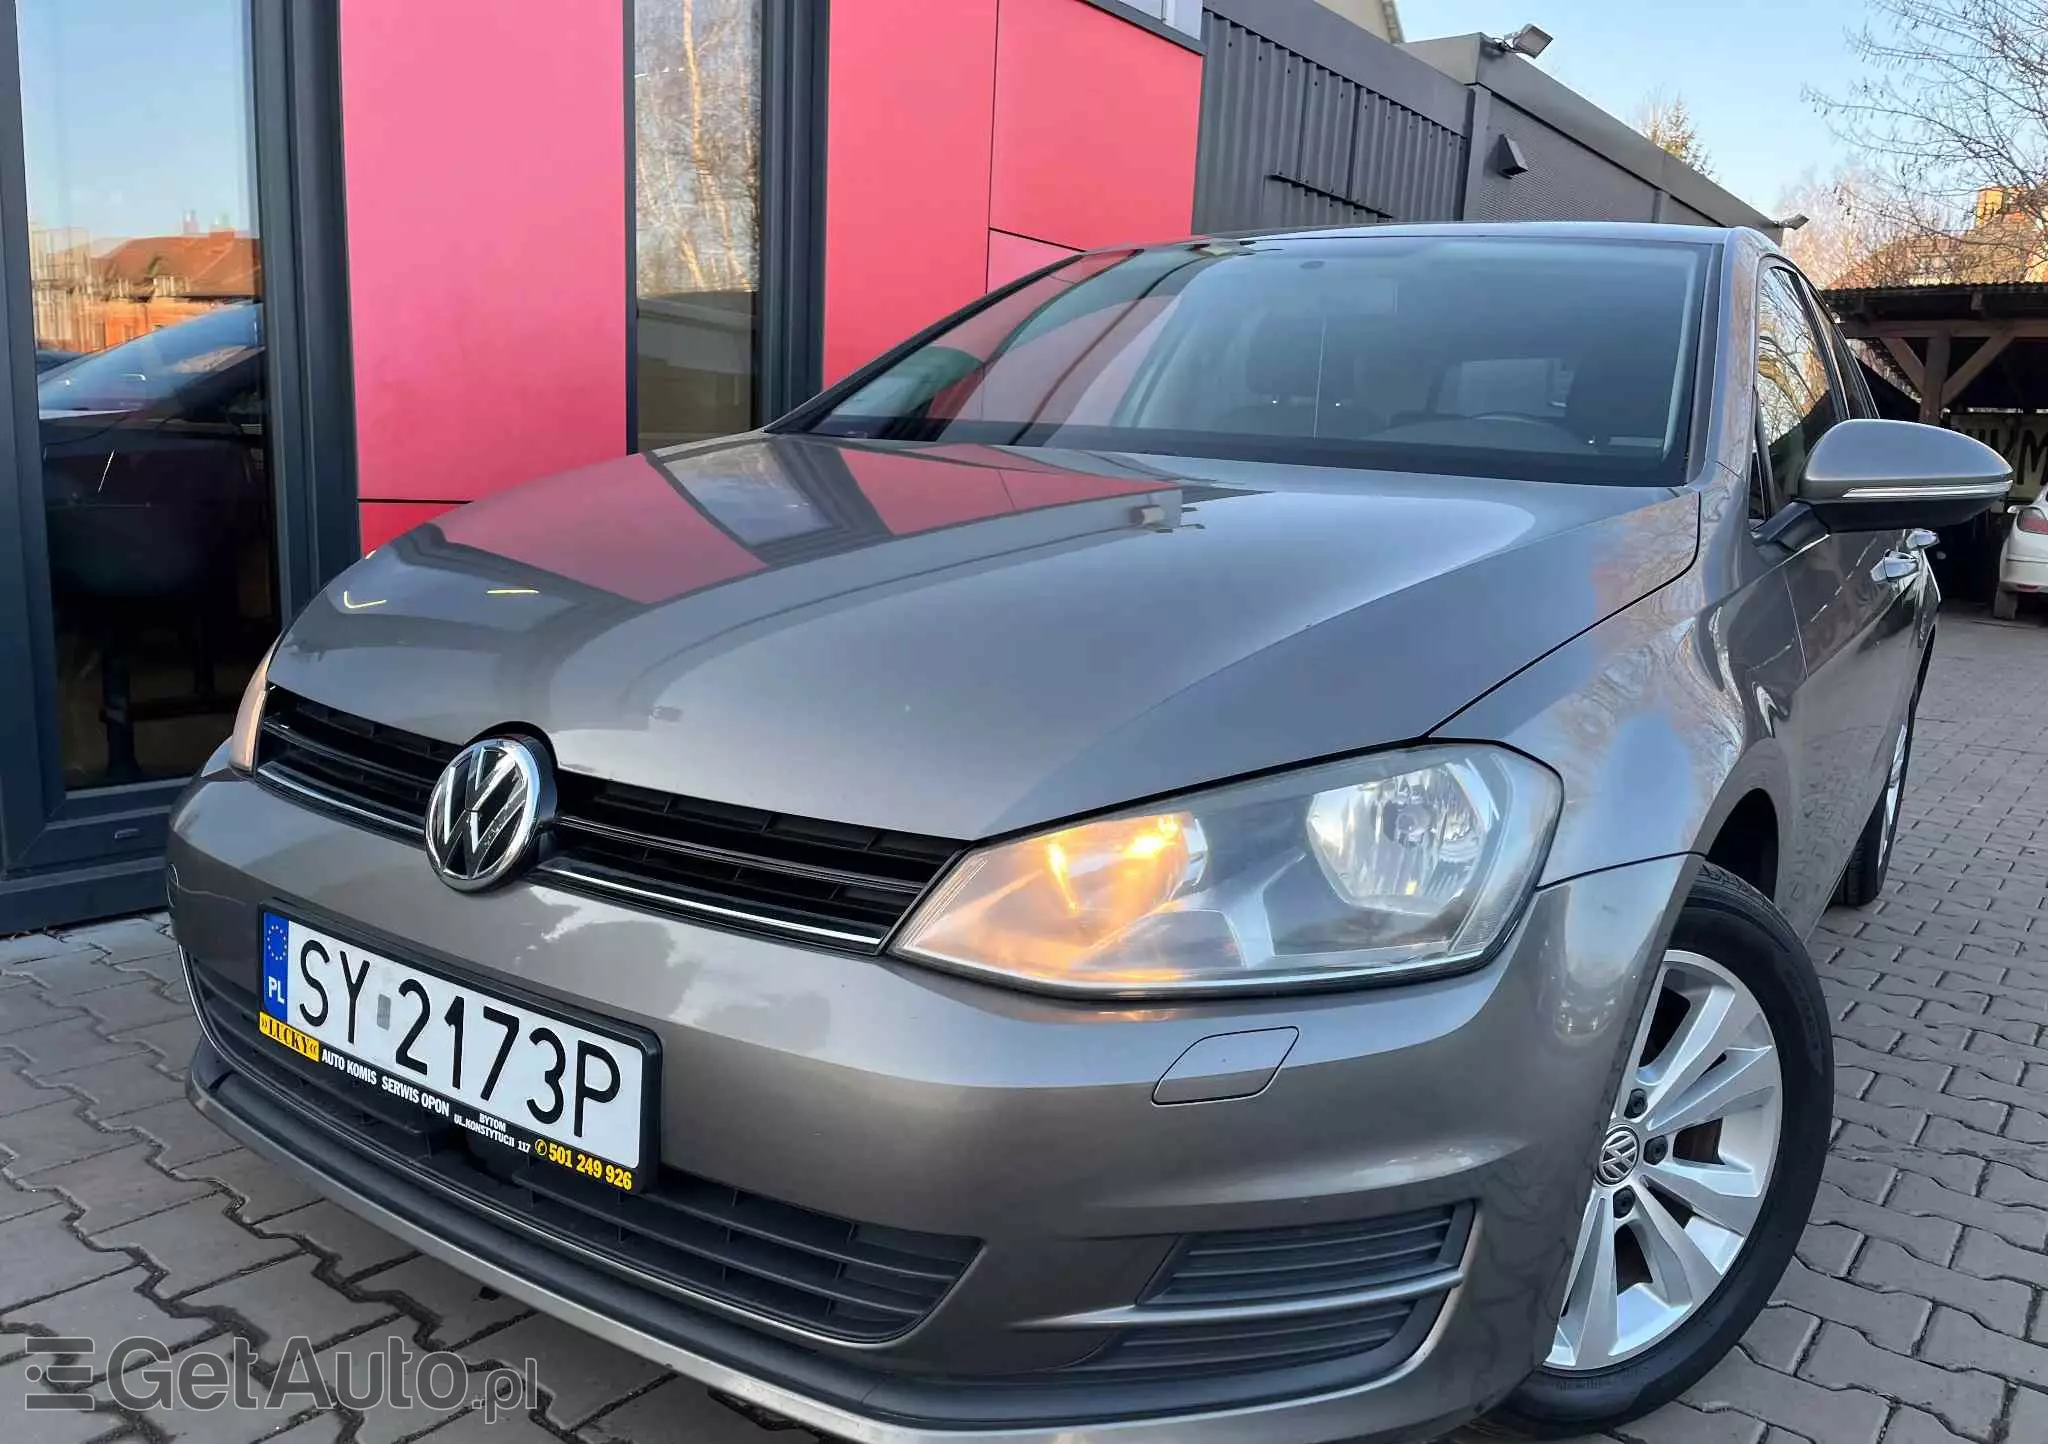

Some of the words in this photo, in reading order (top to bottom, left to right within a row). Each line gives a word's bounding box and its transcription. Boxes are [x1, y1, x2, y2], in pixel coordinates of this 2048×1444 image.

[268, 976, 285, 1004] PL
[299, 939, 371, 1044] SY
[395, 978, 622, 1138] 2173P
[322, 1048, 345, 1071] AUTO
[346, 1059, 377, 1085] KOMIS
[381, 1075, 420, 1104] SERWIS
[420, 1092, 450, 1117] OPON
[479, 1112, 506, 1133] BYTOM
[518, 1140, 531, 1153] 117
[548, 1142, 573, 1168] 501
[576, 1153, 602, 1179] 249
[605, 1165, 632, 1191] 926
